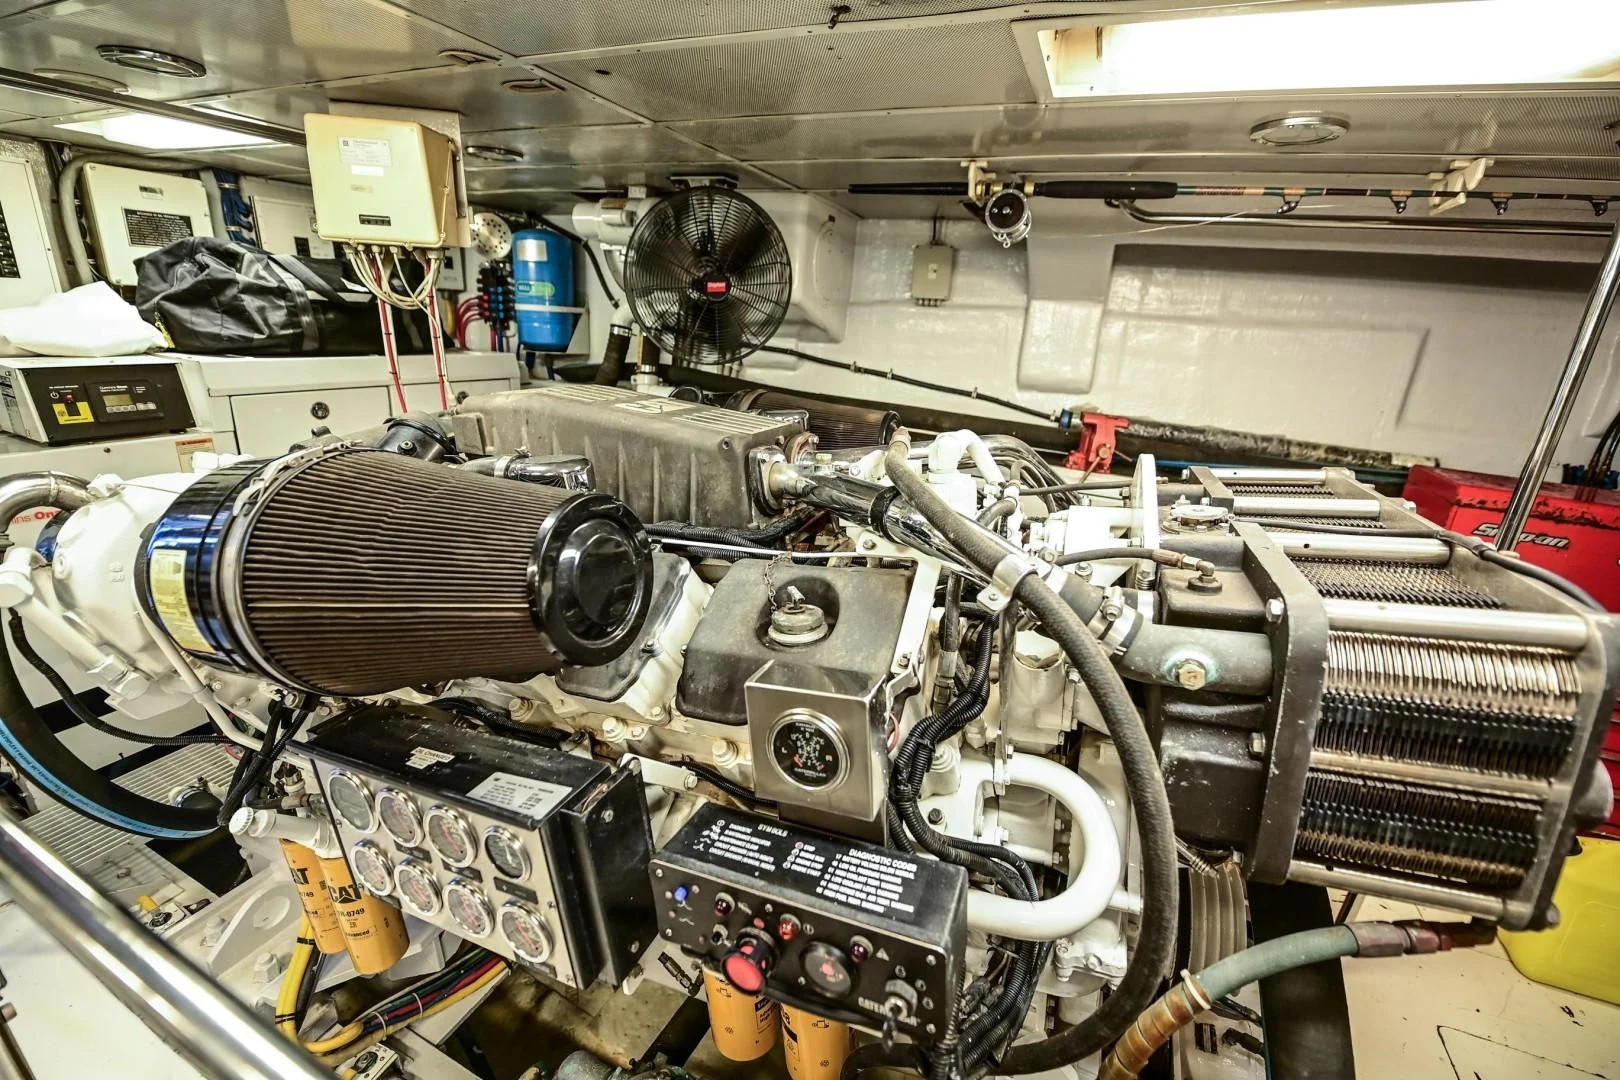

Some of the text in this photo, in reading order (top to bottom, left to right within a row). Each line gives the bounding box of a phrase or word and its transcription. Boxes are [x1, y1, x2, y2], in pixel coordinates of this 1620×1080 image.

[1472, 523, 1569, 548] Sp-on
[757, 823, 788, 837] SYMBOLS
[849, 848, 892, 866] DIAGNOSTIC
[290, 867, 310, 885] AT
[328, 884, 362, 904] CAT
